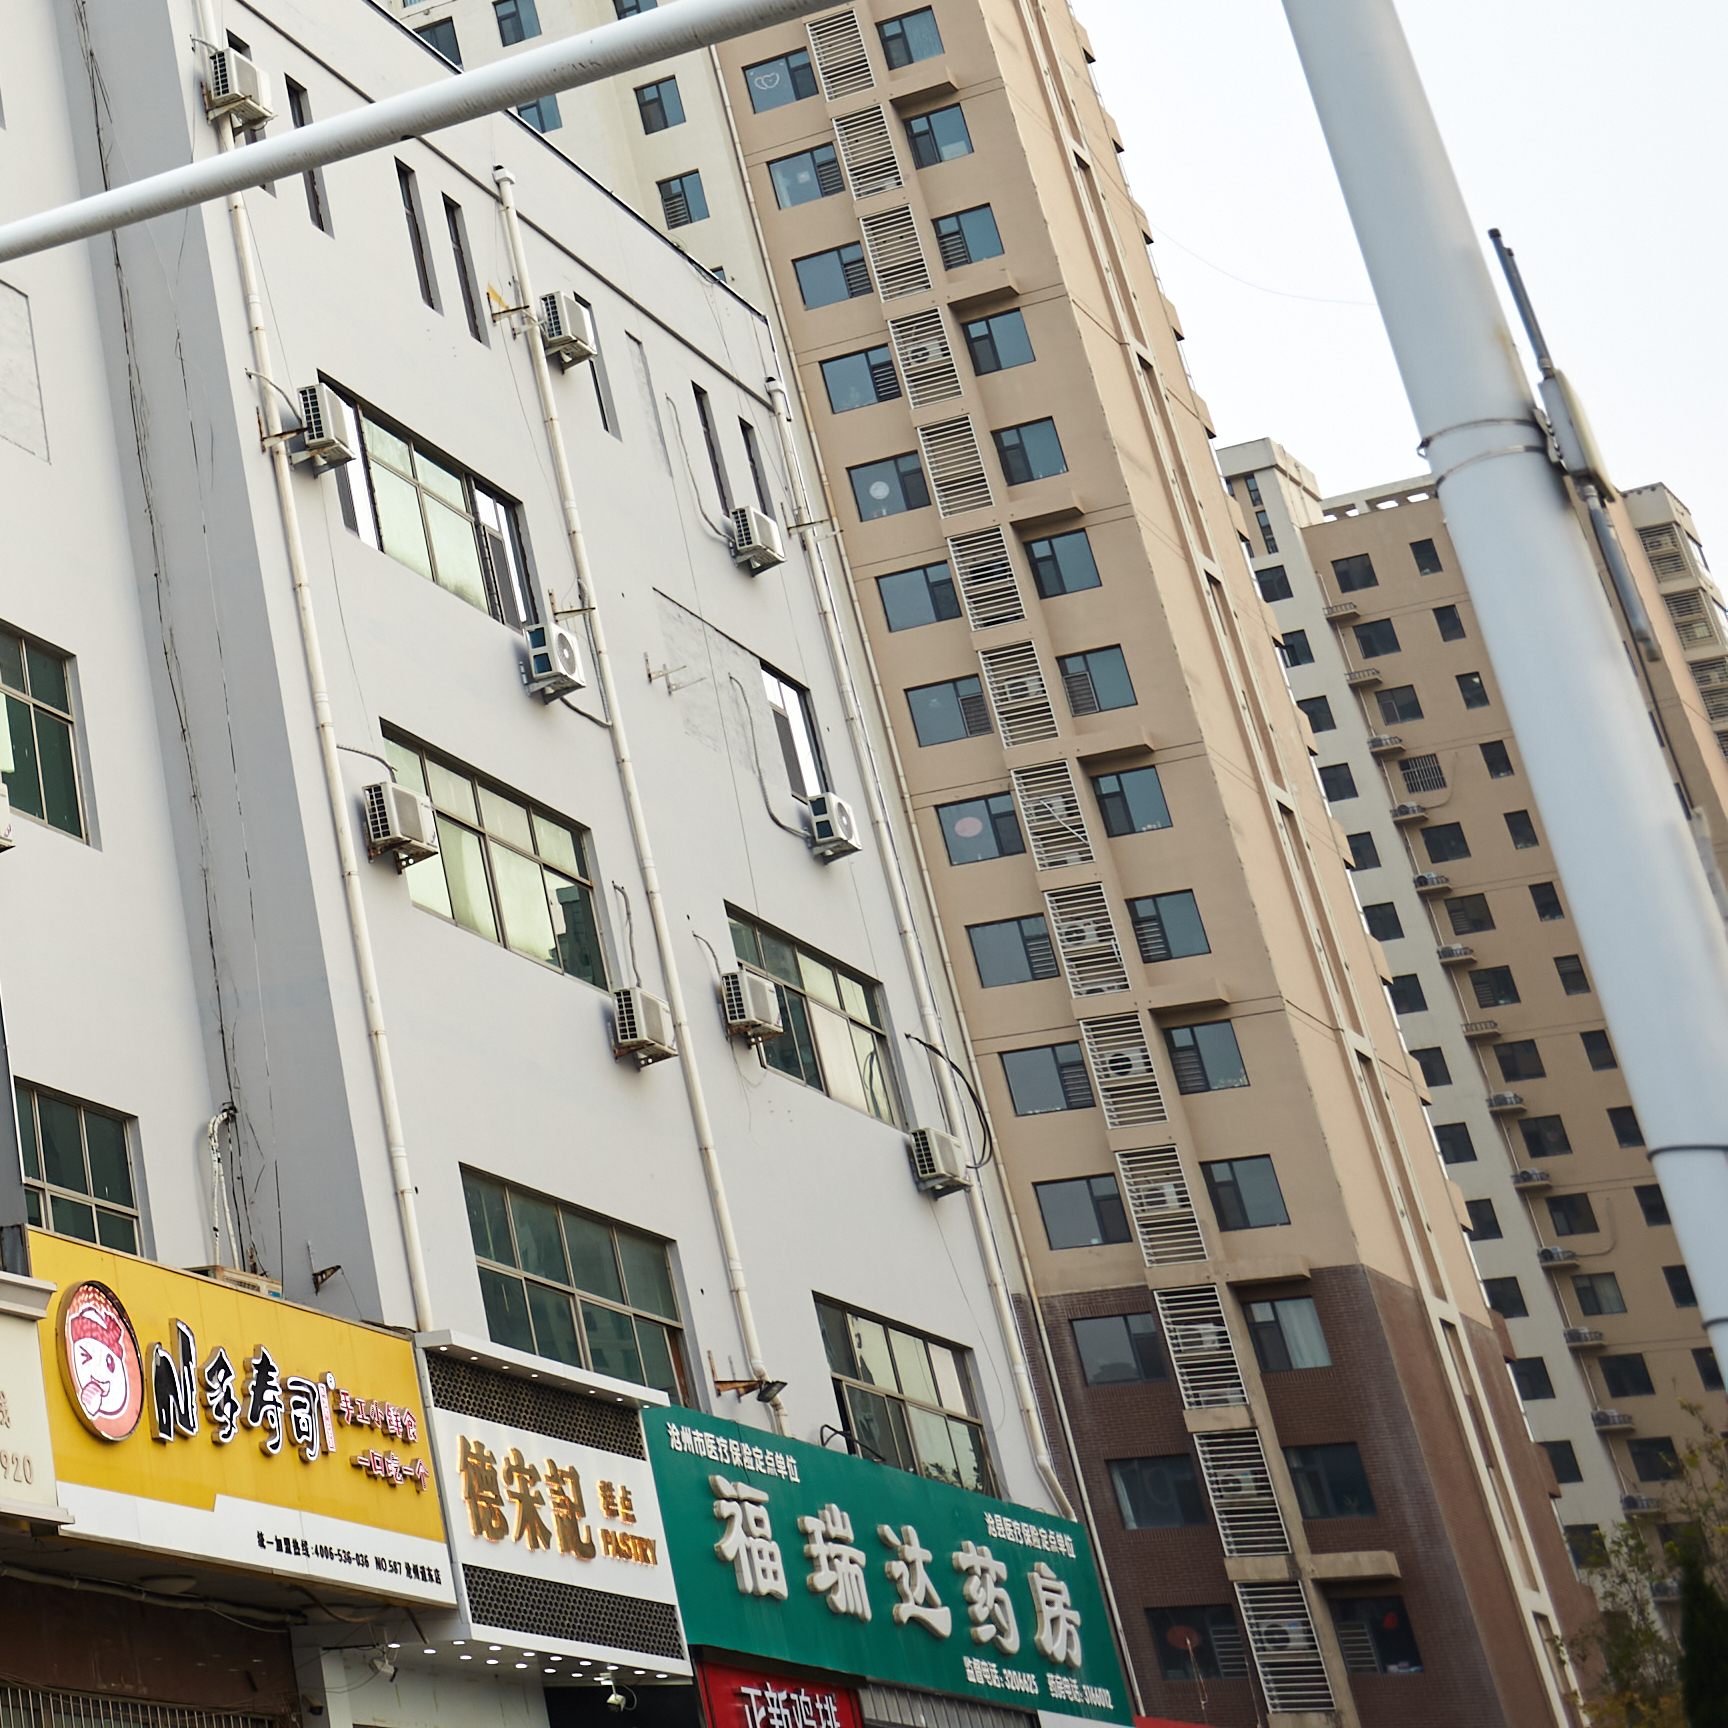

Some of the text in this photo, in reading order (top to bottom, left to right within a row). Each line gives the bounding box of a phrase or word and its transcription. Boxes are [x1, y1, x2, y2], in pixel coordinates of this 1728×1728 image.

[665, 1421, 801, 1484] 沧州市医疗保险定点单位
[598, 1527, 659, 1567] PASTRY
[984, 1511, 1077, 1559] 沧县医疗保险定点单位
[708, 1474, 1084, 1668] 福瑞达药房
